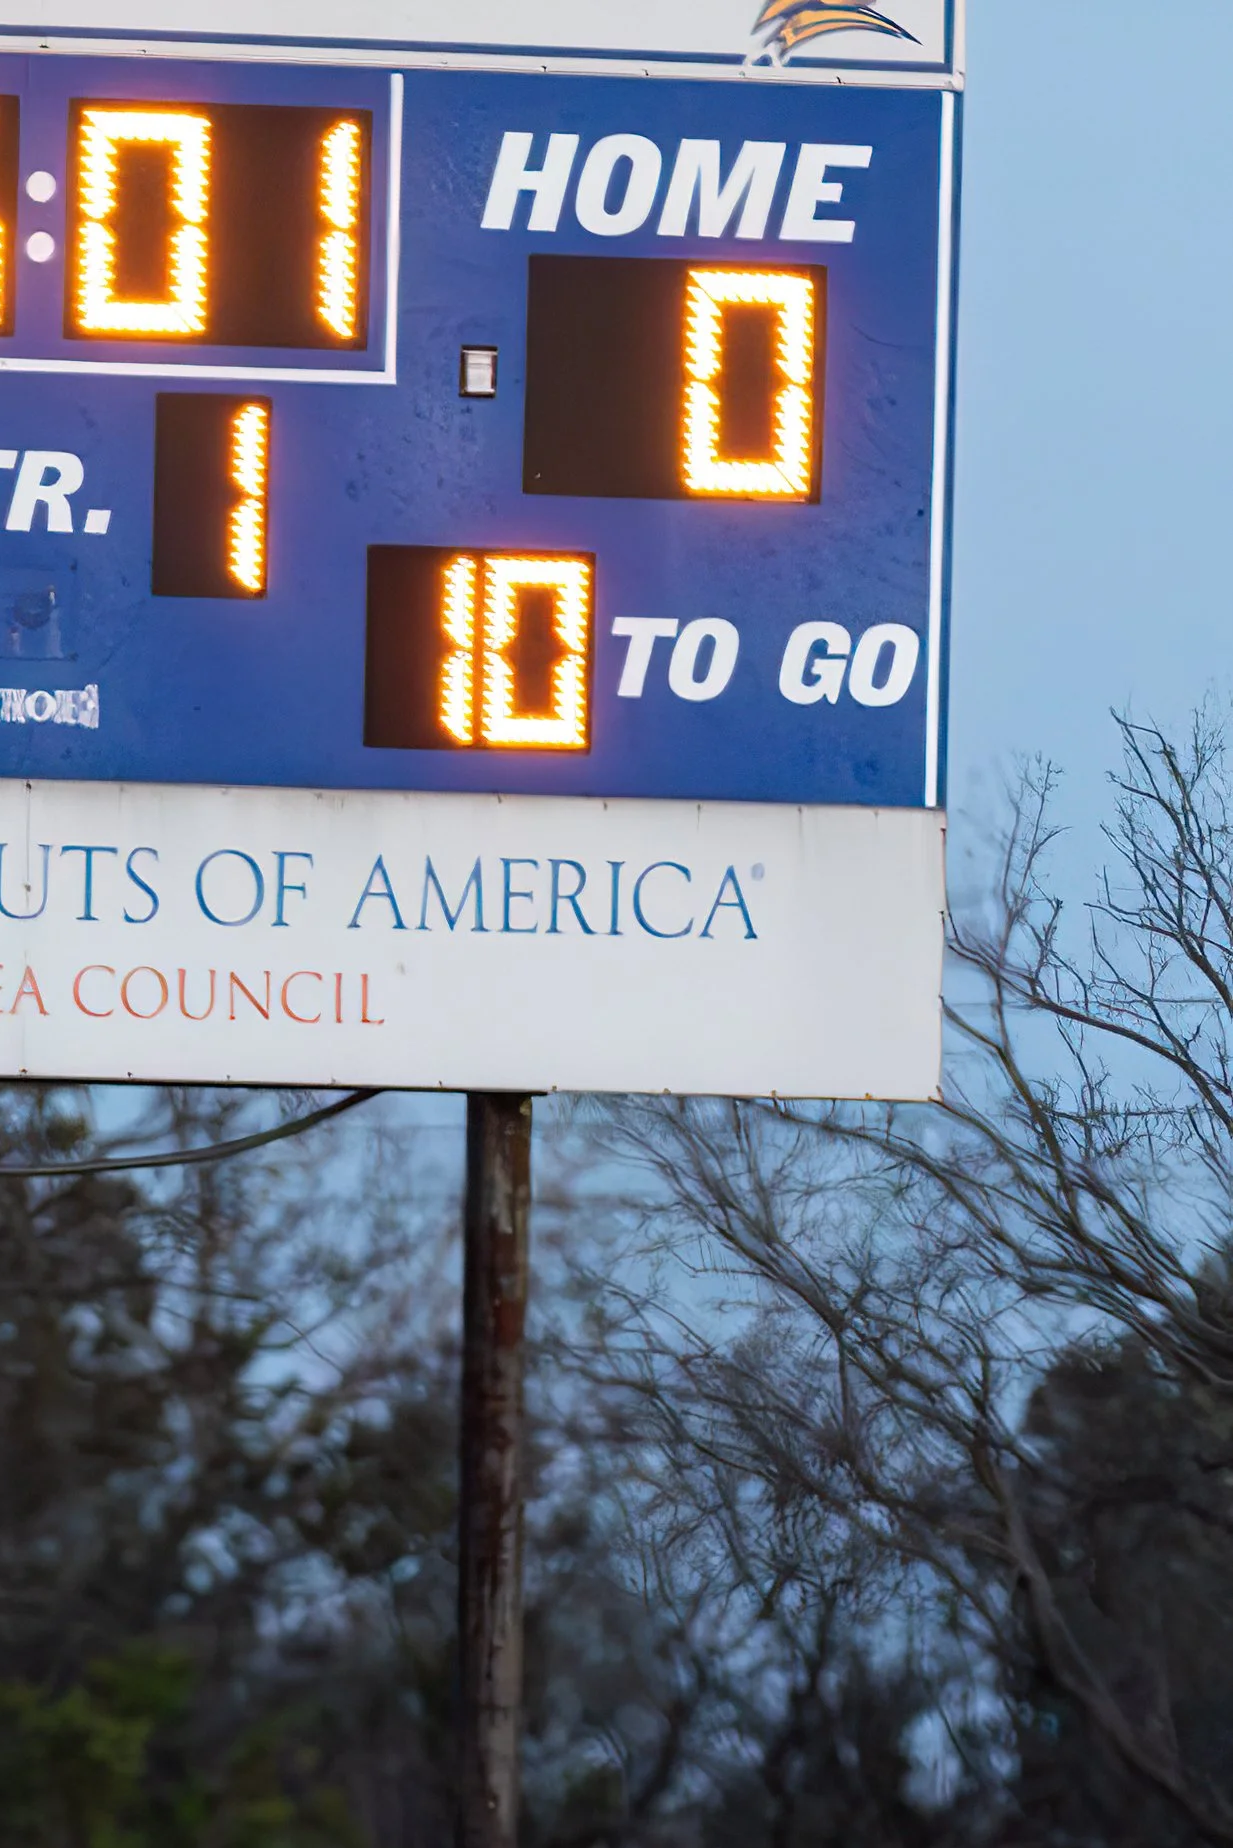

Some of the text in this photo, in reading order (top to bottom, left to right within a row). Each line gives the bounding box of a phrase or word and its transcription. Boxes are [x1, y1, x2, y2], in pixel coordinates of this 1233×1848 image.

[480, 131, 873, 243] HOME
[683, 267, 814, 496] 0
[228, 403, 267, 592] 1
[438, 553, 920, 750] 10 TO GO
[195, 848, 315, 928] OF
[347, 853, 761, 941] AMERICA
[73, 965, 385, 1026] COUNCIL
